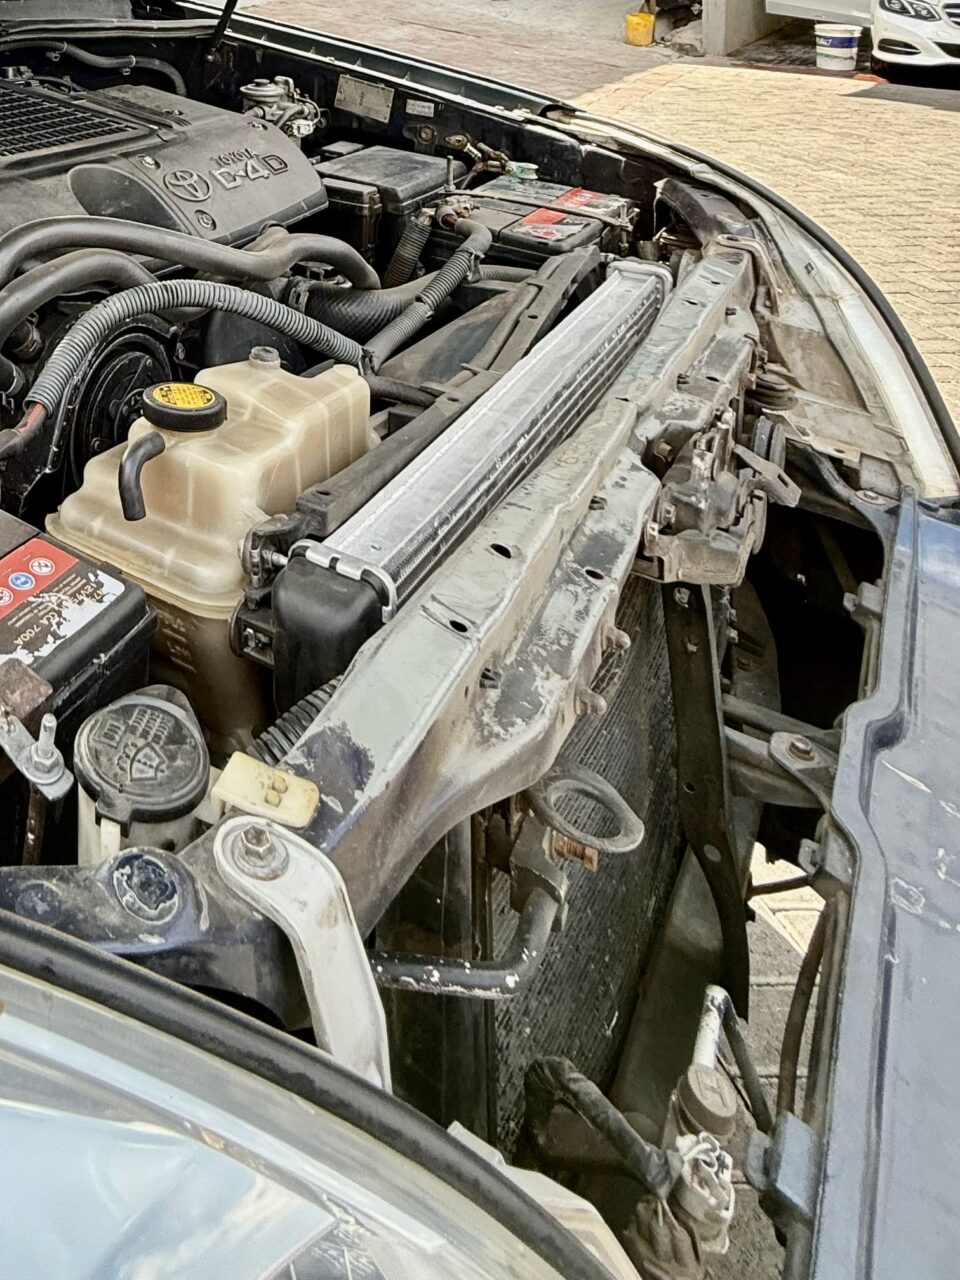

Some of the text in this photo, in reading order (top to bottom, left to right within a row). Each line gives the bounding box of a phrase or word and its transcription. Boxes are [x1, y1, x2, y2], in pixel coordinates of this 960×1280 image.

[213, 147, 259, 168] TOYOTA
[209, 154, 289, 191] D-4D
[13, 624, 42, 646] 700A
